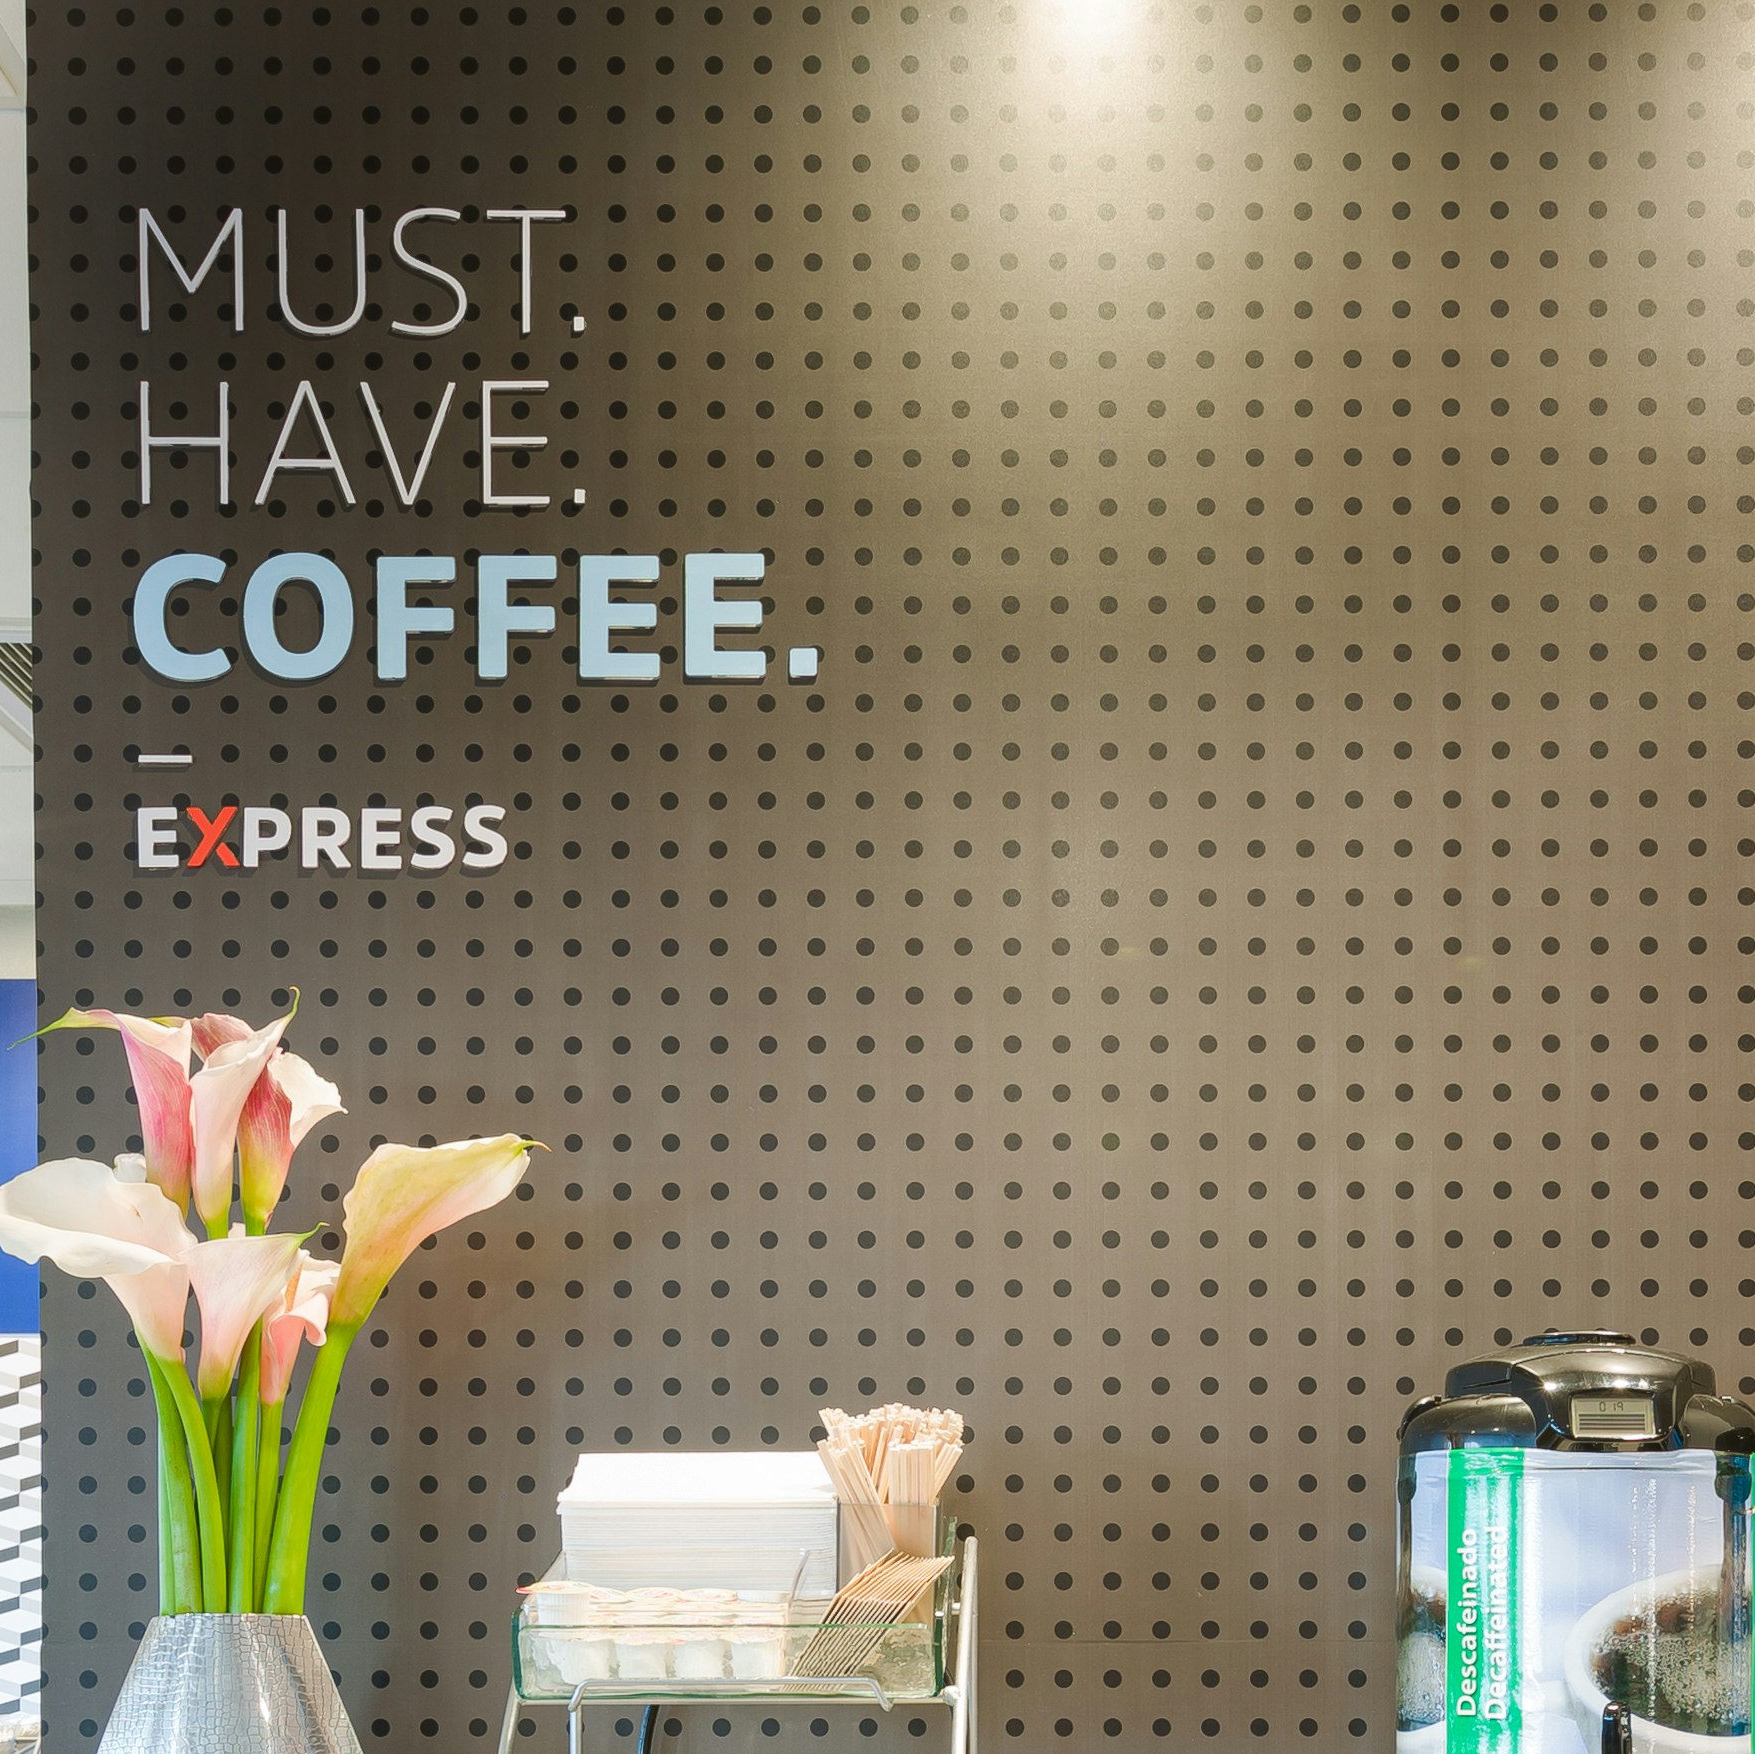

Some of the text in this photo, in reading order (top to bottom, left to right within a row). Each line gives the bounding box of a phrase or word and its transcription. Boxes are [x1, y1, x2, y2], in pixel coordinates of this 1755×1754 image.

[139, 207, 587, 337] MUST.
[139, 380, 587, 506] HAVE.
[132, 551, 820, 682] COFFEE.
[137, 804, 508, 870] EXPRESS
[1456, 1528, 1477, 1716] Descafeinado
[1484, 1525, 1508, 1720] Decaffeinated
